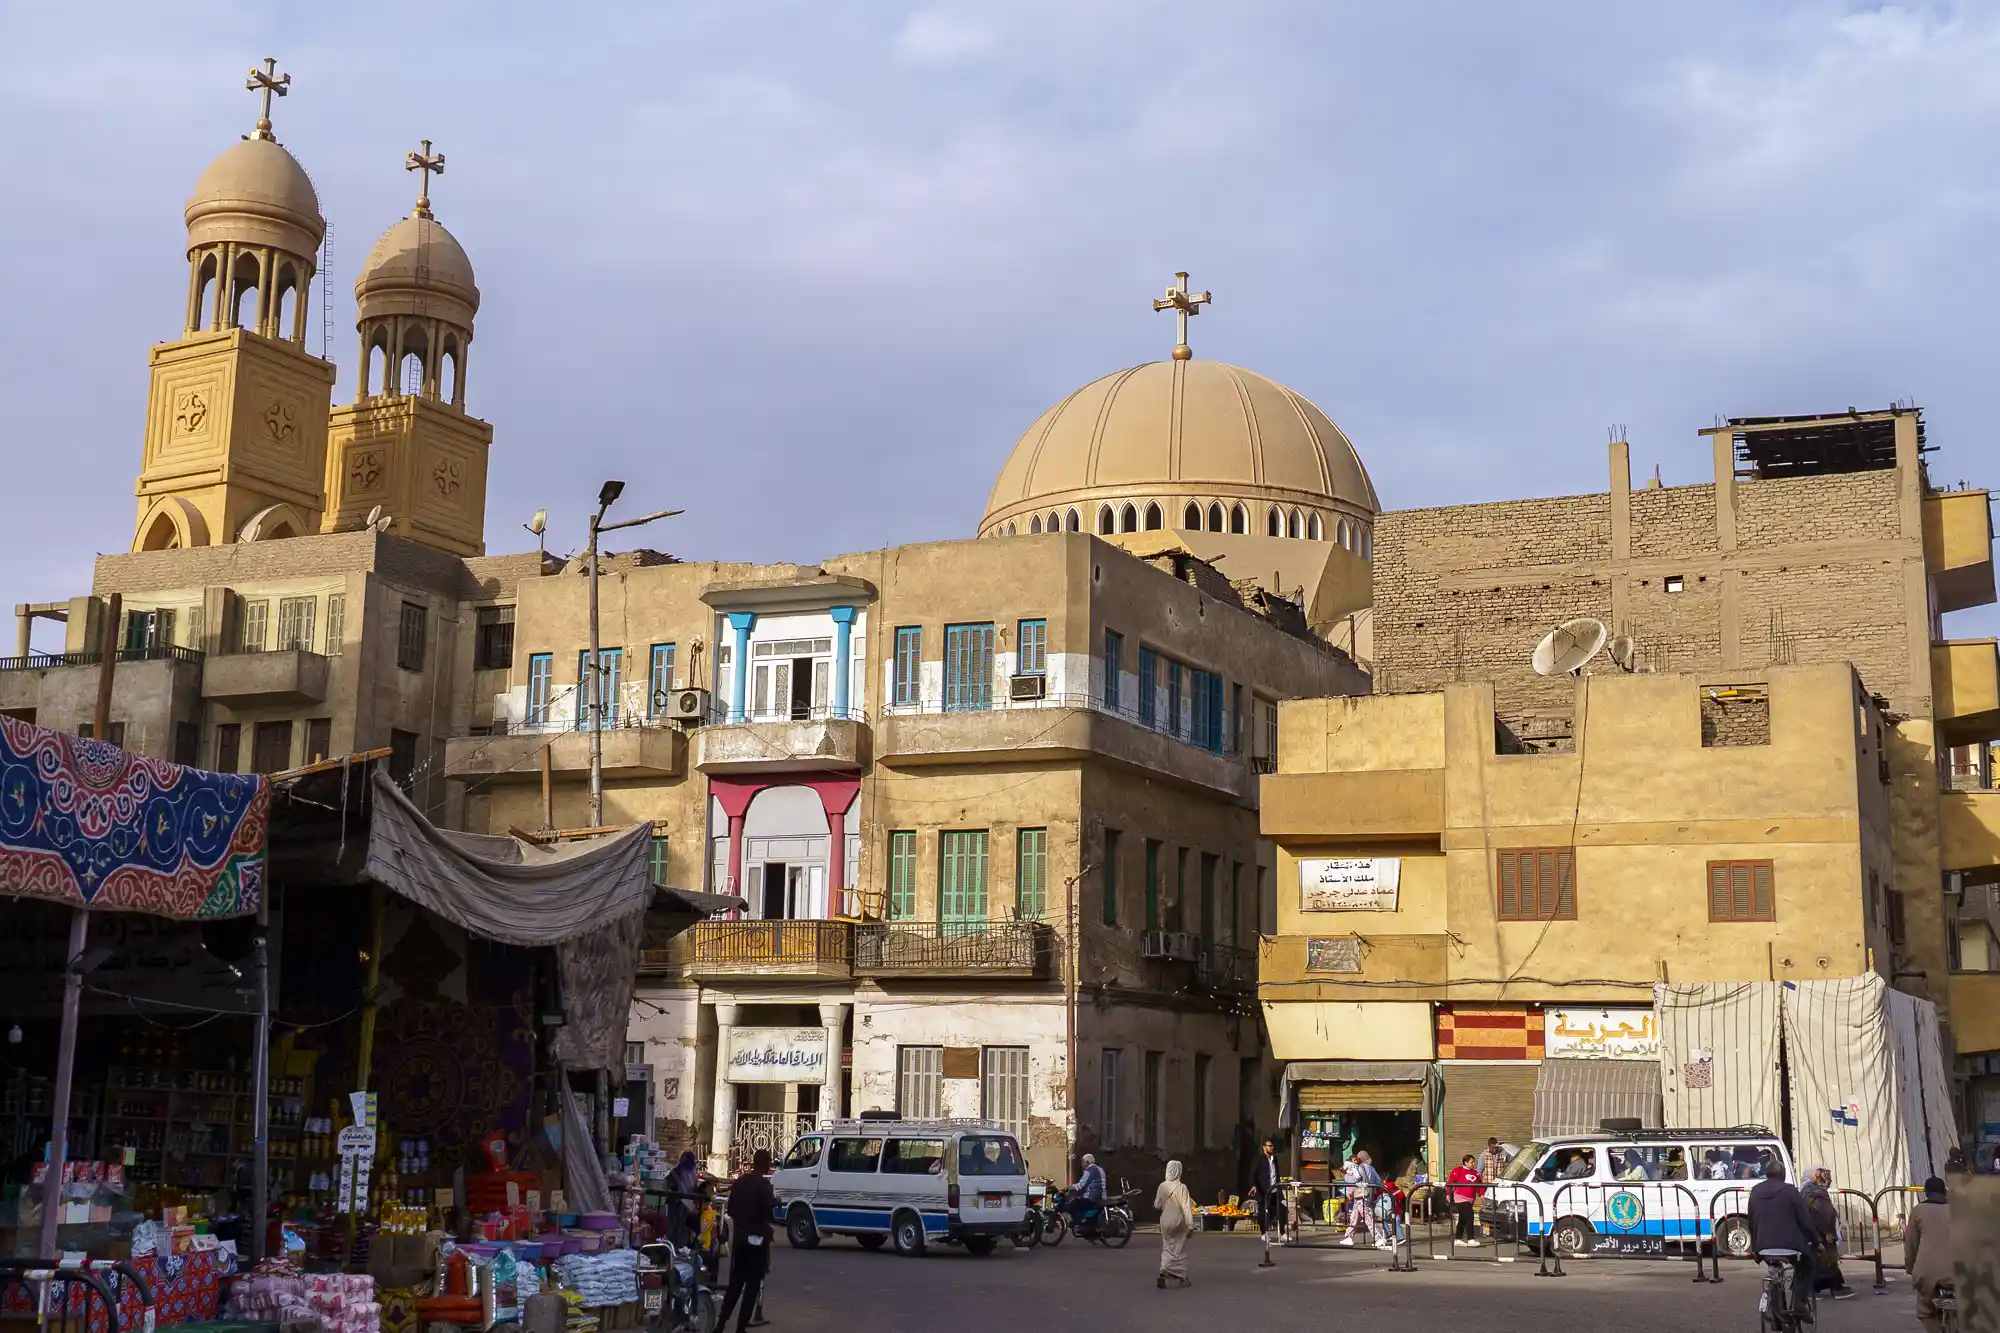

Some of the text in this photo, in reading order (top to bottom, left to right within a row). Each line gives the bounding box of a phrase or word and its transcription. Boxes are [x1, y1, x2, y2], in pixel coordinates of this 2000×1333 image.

[1354, 874, 1374, 882] ملك
[769, 1050, 793, 1066] العامة
[1592, 1236, 1662, 1253] إدارة مرور الأقصر
